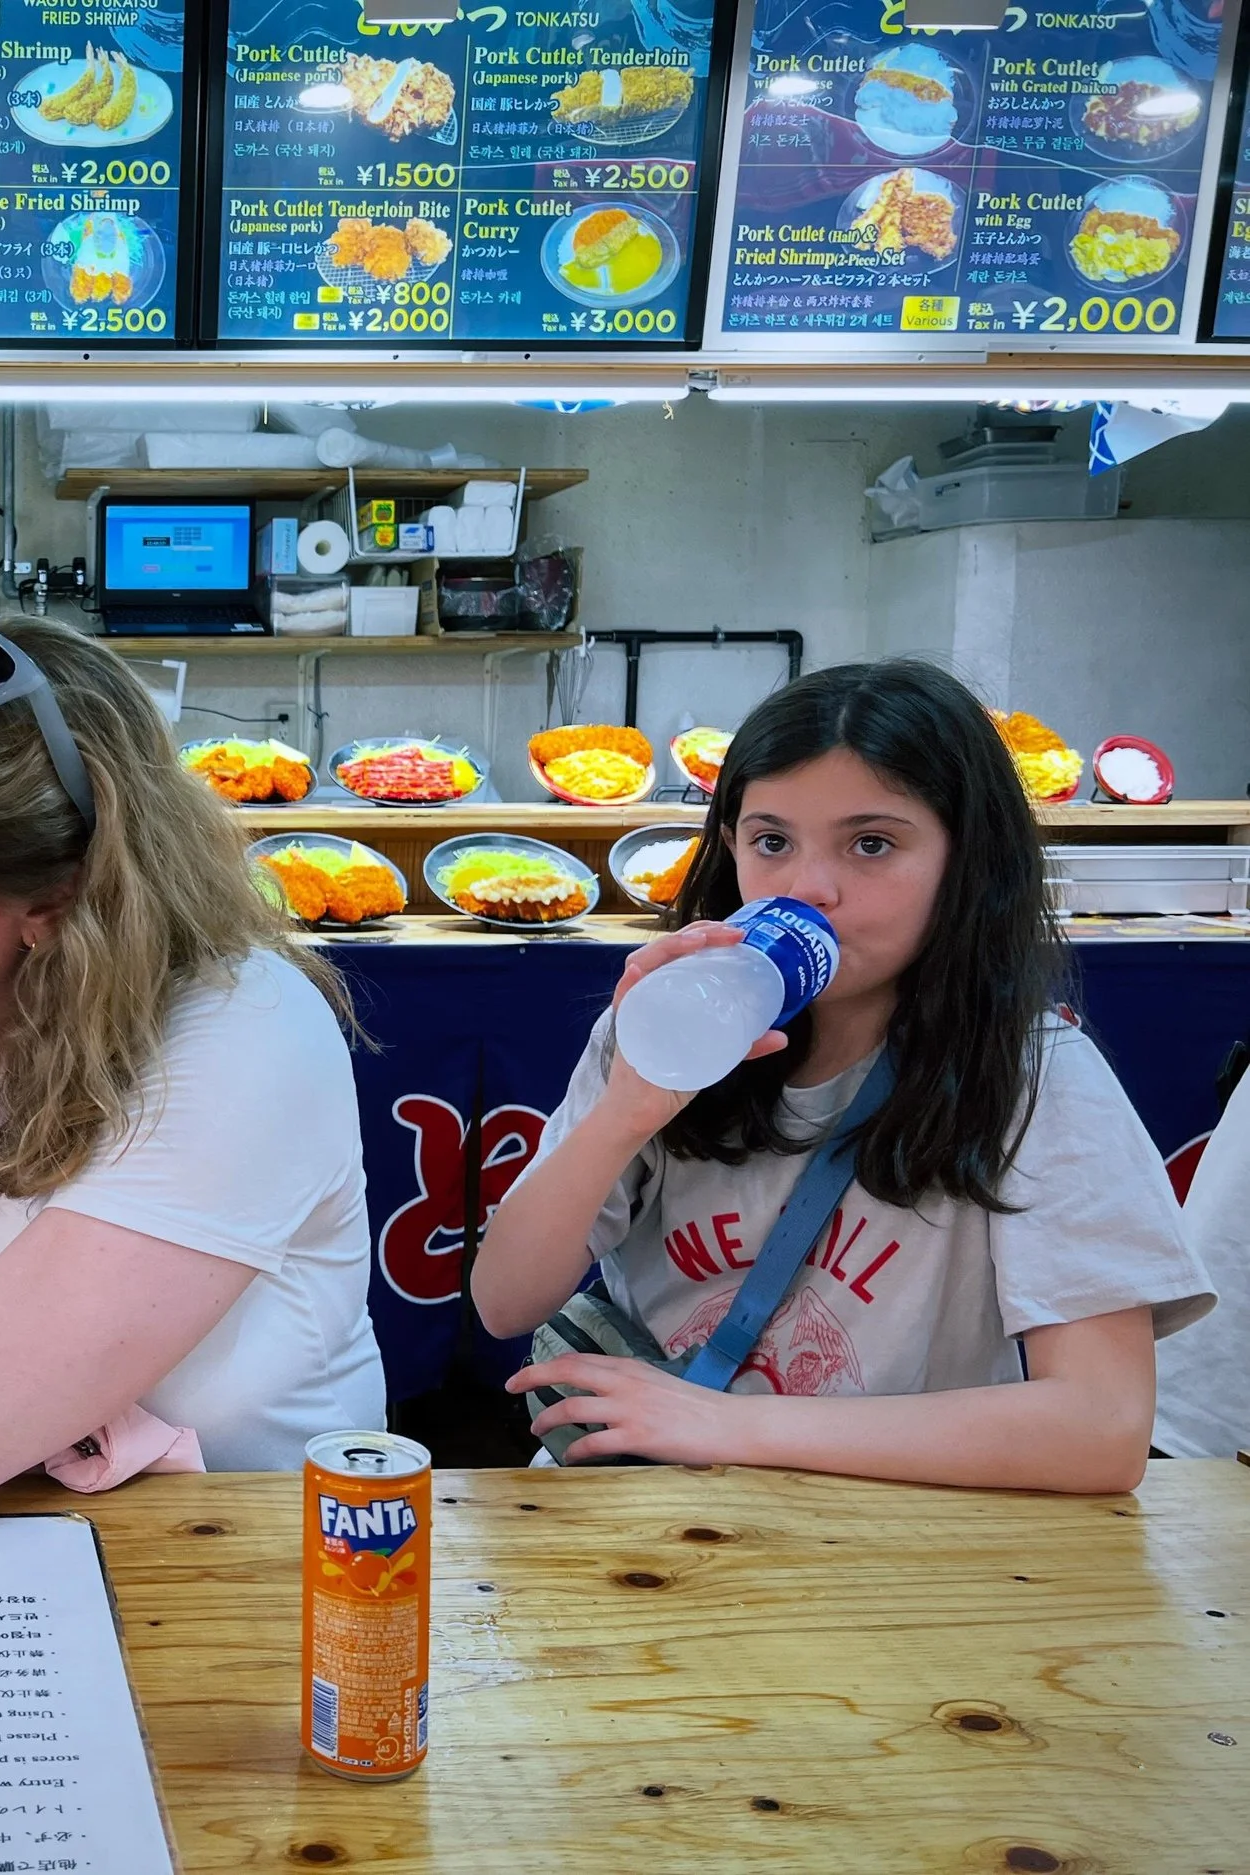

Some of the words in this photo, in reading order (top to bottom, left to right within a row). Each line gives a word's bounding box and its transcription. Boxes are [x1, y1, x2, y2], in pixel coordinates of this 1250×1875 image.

[42, 12, 80, 25] FRIED
[85, 12, 139, 26] SHRIMP
[516, 12, 599, 27] TONKATSU
[1036, 13, 1116, 29] TONKATSU
[1, 42, 72, 63] Shrimp
[236, 45, 281, 62] Pork
[288, 45, 347, 63] Cutlet
[474, 47, 519, 64] Pork
[526, 47, 583, 65] Cutlet
[590, 48, 689, 65] Tenderloin
[755, 55, 800, 72] Pork
[807, 56, 866, 73] Cutlet
[992, 58, 1036, 75] Pork
[1042, 59, 1098, 77] Cutlet
[235, 70, 300, 84] (Japanese
[305, 69, 342, 84] pork)
[473, 71, 537, 85] (Japanese
[541, 72, 579, 87] pork)
[990, 81, 1017, 92] with
[1022, 80, 1066, 93] Grated
[1071, 81, 1116, 94] Daikon
[61, 161, 171, 185] ¥2,000
[357, 163, 456, 187] ¥1,500
[584, 165, 689, 189] ¥2,500
[14, 194, 65, 210] Fried
[71, 194, 140, 215] Shrimp
[230, 200, 268, 217] Pork
[273, 200, 323, 217] Cutlet
[328, 201, 413, 217] Tenderloin
[419, 202, 450, 217] Bite
[465, 200, 508, 215] Pork
[515, 200, 572, 216] Cutlet
[976, 193, 1021, 209] Pork
[1027, 193, 1083, 210] Cutlet
[230, 221, 287, 235] (Japanese
[290, 221, 323, 235] pork)
[975, 215, 1002, 226] with
[1006, 214, 1031, 229] Egg
[463, 223, 520, 243] Curry
[737, 225, 774, 241] Pork
[778, 225, 825, 241] Cutlet
[972, 232, 1042, 245] 玉子とんかつ
[462, 245, 519, 258] かつカレー
[734, 248, 775, 265] Fried
[882, 251, 906, 265] Set
[376, 283, 450, 305] ¥800
[62, 308, 166, 332] ¥2,500
[348, 308, 449, 332] ¥2,000
[570, 309, 676, 333] ¥3,000
[907, 315, 954, 327] Various
[967, 319, 990, 330] Tax
[993, 319, 1005, 330] in
[1012, 297, 1176, 332] ¥2,000
[763, 907, 828, 997] AQUARIUS
[664, 1212, 755, 1282] WE
[320, 1496, 417, 1539] FANTA
[7, 1710, 53, 1719] Using
[7, 1732, 57, 1742] Please
[32, 1755, 80, 1763] stores
[19, 1778, 64, 1789] Entry
